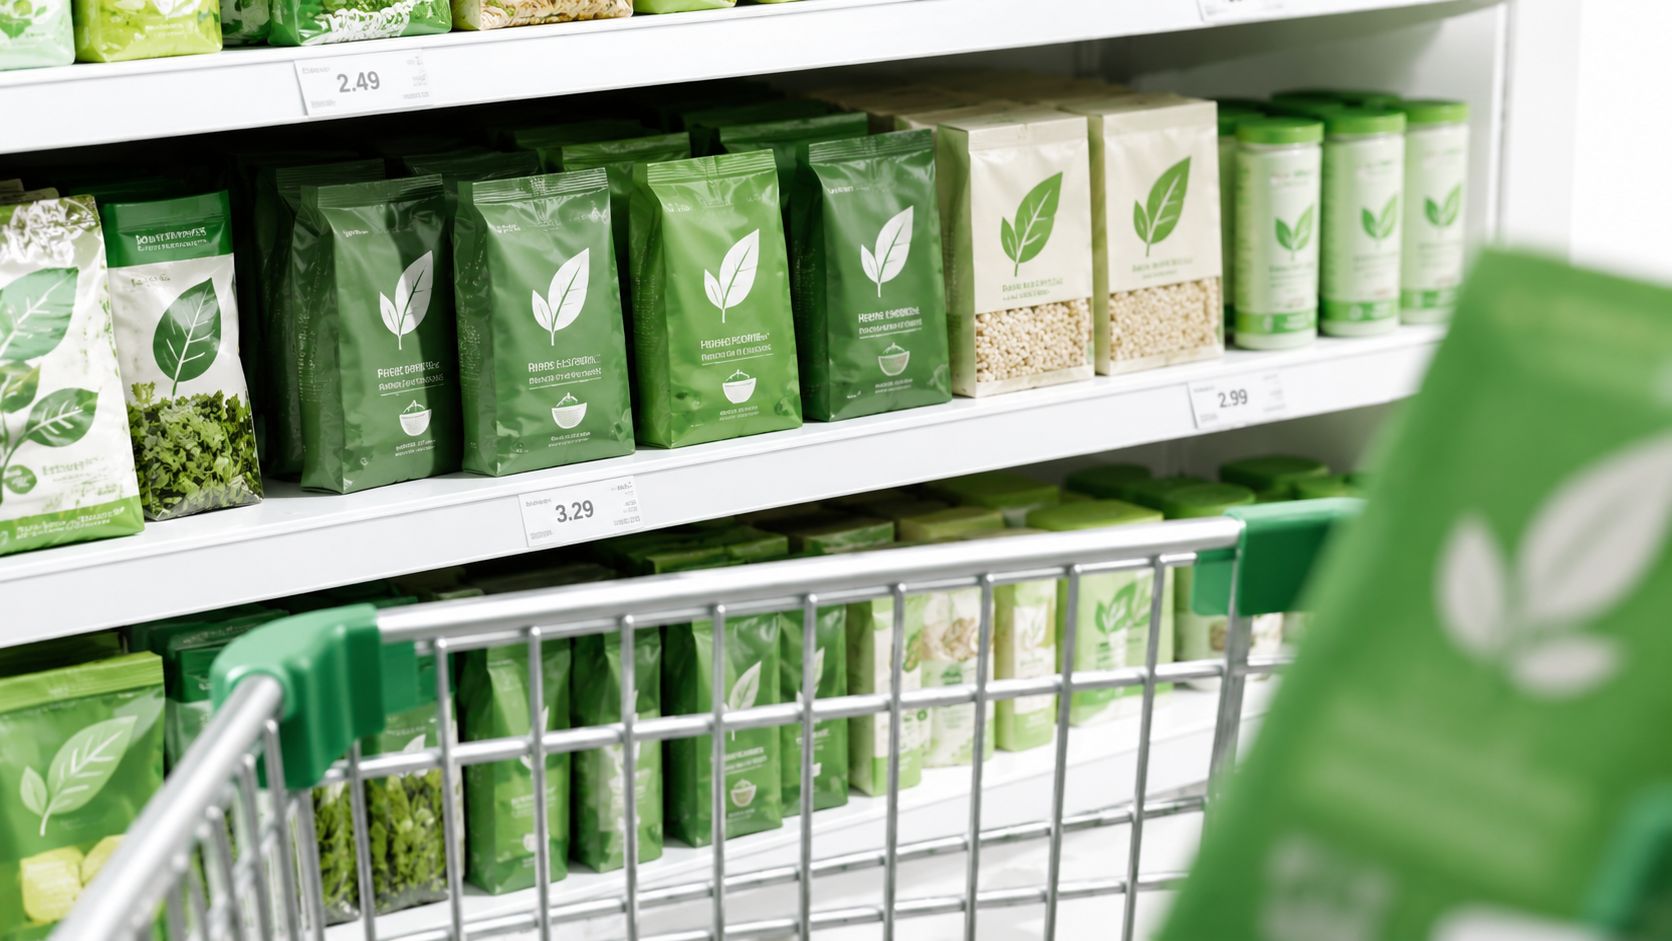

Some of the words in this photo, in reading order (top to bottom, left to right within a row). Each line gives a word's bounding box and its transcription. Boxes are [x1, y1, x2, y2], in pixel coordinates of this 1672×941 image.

[337, 71, 380, 93] 2.49
[1218, 389, 1248, 408] 2.99
[555, 500, 594, 523] 3.29
